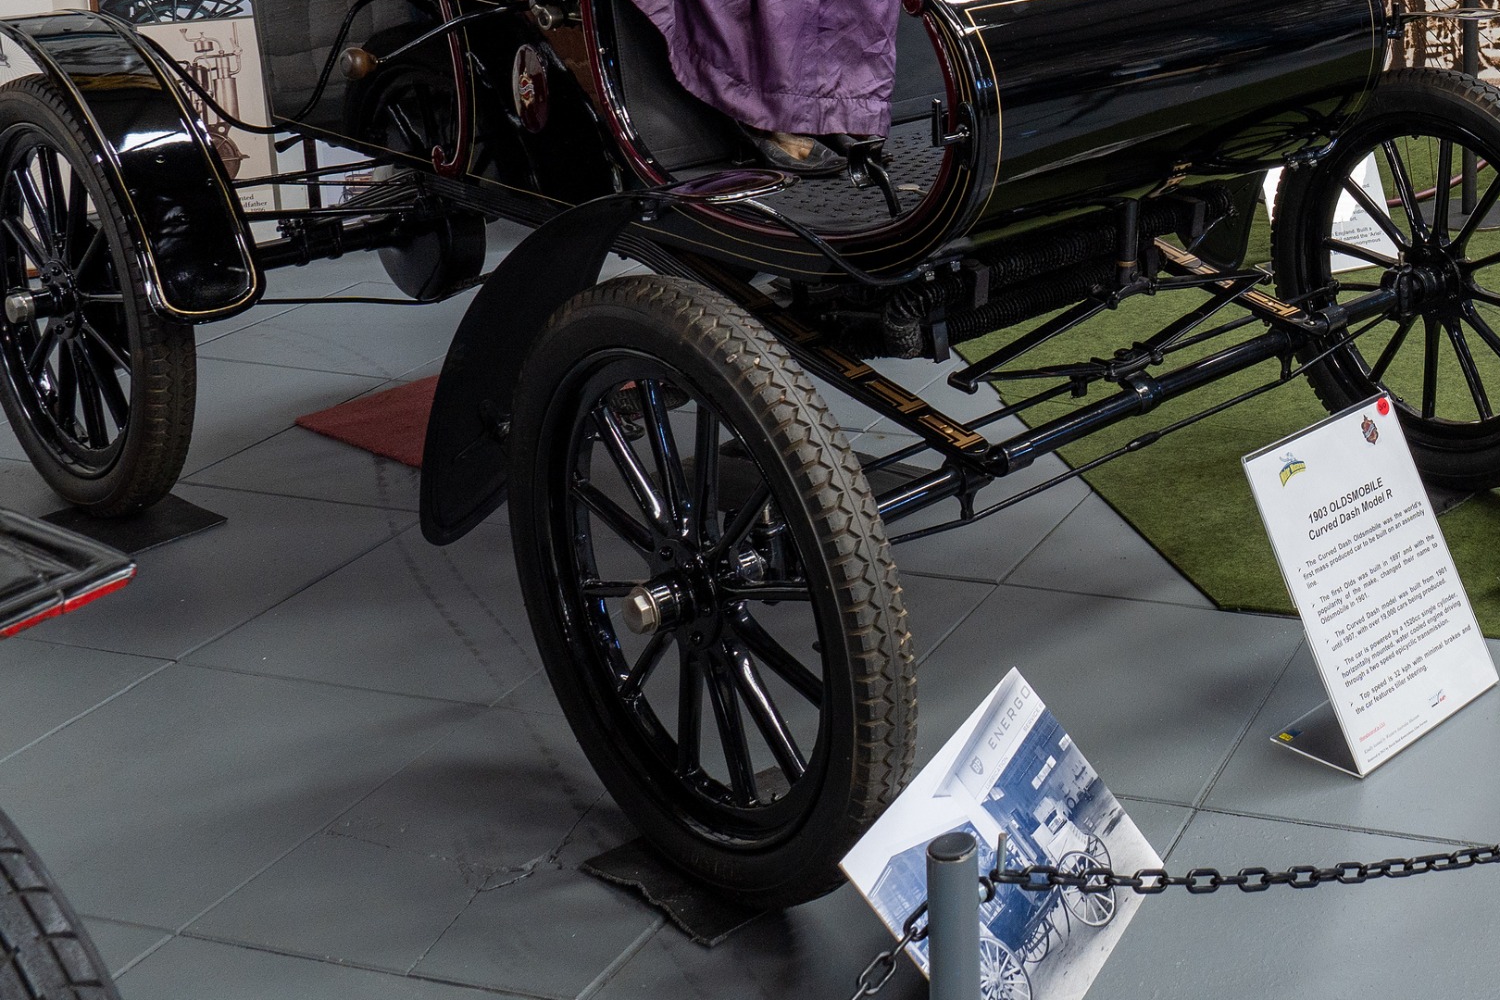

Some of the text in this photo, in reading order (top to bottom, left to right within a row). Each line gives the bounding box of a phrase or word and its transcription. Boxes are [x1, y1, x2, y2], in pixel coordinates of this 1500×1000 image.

[1308, 476, 1383, 524] 1903 OLDSMOBILE
[1308, 488, 1393, 540] Curved Dash Model R
[1302, 569, 1315, 580] first
[1314, 562, 1329, 574] mass
[1329, 547, 1354, 567] produced
[1353, 543, 1362, 552] car
[1375, 529, 1387, 540] built
[1394, 521, 1401, 529] an
[1401, 509, 1424, 525] assembly
[1305, 501, 1422, 567] The Curved Dash Oldsmobile was the world's
[1317, 597, 1343, 617] popularity
[1344, 590, 1351, 599] of
[1352, 586, 1361, 595] the
[1380, 561, 1401, 578] changed
[1402, 555, 1414, 565] their
[1416, 546, 1430, 557] name
[1319, 594, 1330, 603] The
[1330, 586, 1343, 596] first
[1343, 579, 1356, 589] Olds
[1357, 571, 1368, 581] was
[1369, 563, 1381, 574] built
[1402, 545, 1412, 555] and
[1413, 539, 1424, 548] with
[1425, 534, 1434, 542] the
[1320, 604, 1349, 624] Oldsmobile
[1331, 640, 1343, 651] until
[1357, 625, 1368, 635] with
[1368, 618, 1379, 628] over
[1396, 601, 1408, 611] cars
[1407, 592, 1422, 604] being
[1334, 628, 1345, 637] The
[1345, 615, 1365, 631] Curved
[1365, 607, 1380, 619] Dash
[1381, 596, 1397, 609] model
[1397, 590, 1408, 599] was
[1408, 582, 1421, 593] built
[1421, 575, 1434, 584] from
[1343, 656, 1354, 665] The
[1354, 650, 1363, 659] car
[1369, 631, 1392, 650] powered
[1420, 605, 1436, 617] single
[1341, 657, 1370, 678] horizontally
[1395, 632, 1408, 644] water
[1409, 620, 1426, 635] cooled
[1426, 610, 1443, 624] engine
[1443, 600, 1461, 613] driving
[1344, 671, 1365, 687] through
[1368, 662, 1379, 671] two
[1379, 651, 1395, 665] speed
[1395, 638, 1417, 655] epicyclic
[1359, 690, 1370, 700] Top
[1370, 678, 1387, 693] speed
[1401, 663, 1411, 672] kph
[1411, 656, 1423, 666] with
[1423, 641, 1443, 658] minimal
[1443, 632, 1461, 645] brakes
[1461, 624, 1471, 634] and
[1355, 705, 1365, 714] the
[1365, 699, 1373, 708] car
[1373, 686, 1395, 702] features
[1394, 677, 1406, 688] tiller
